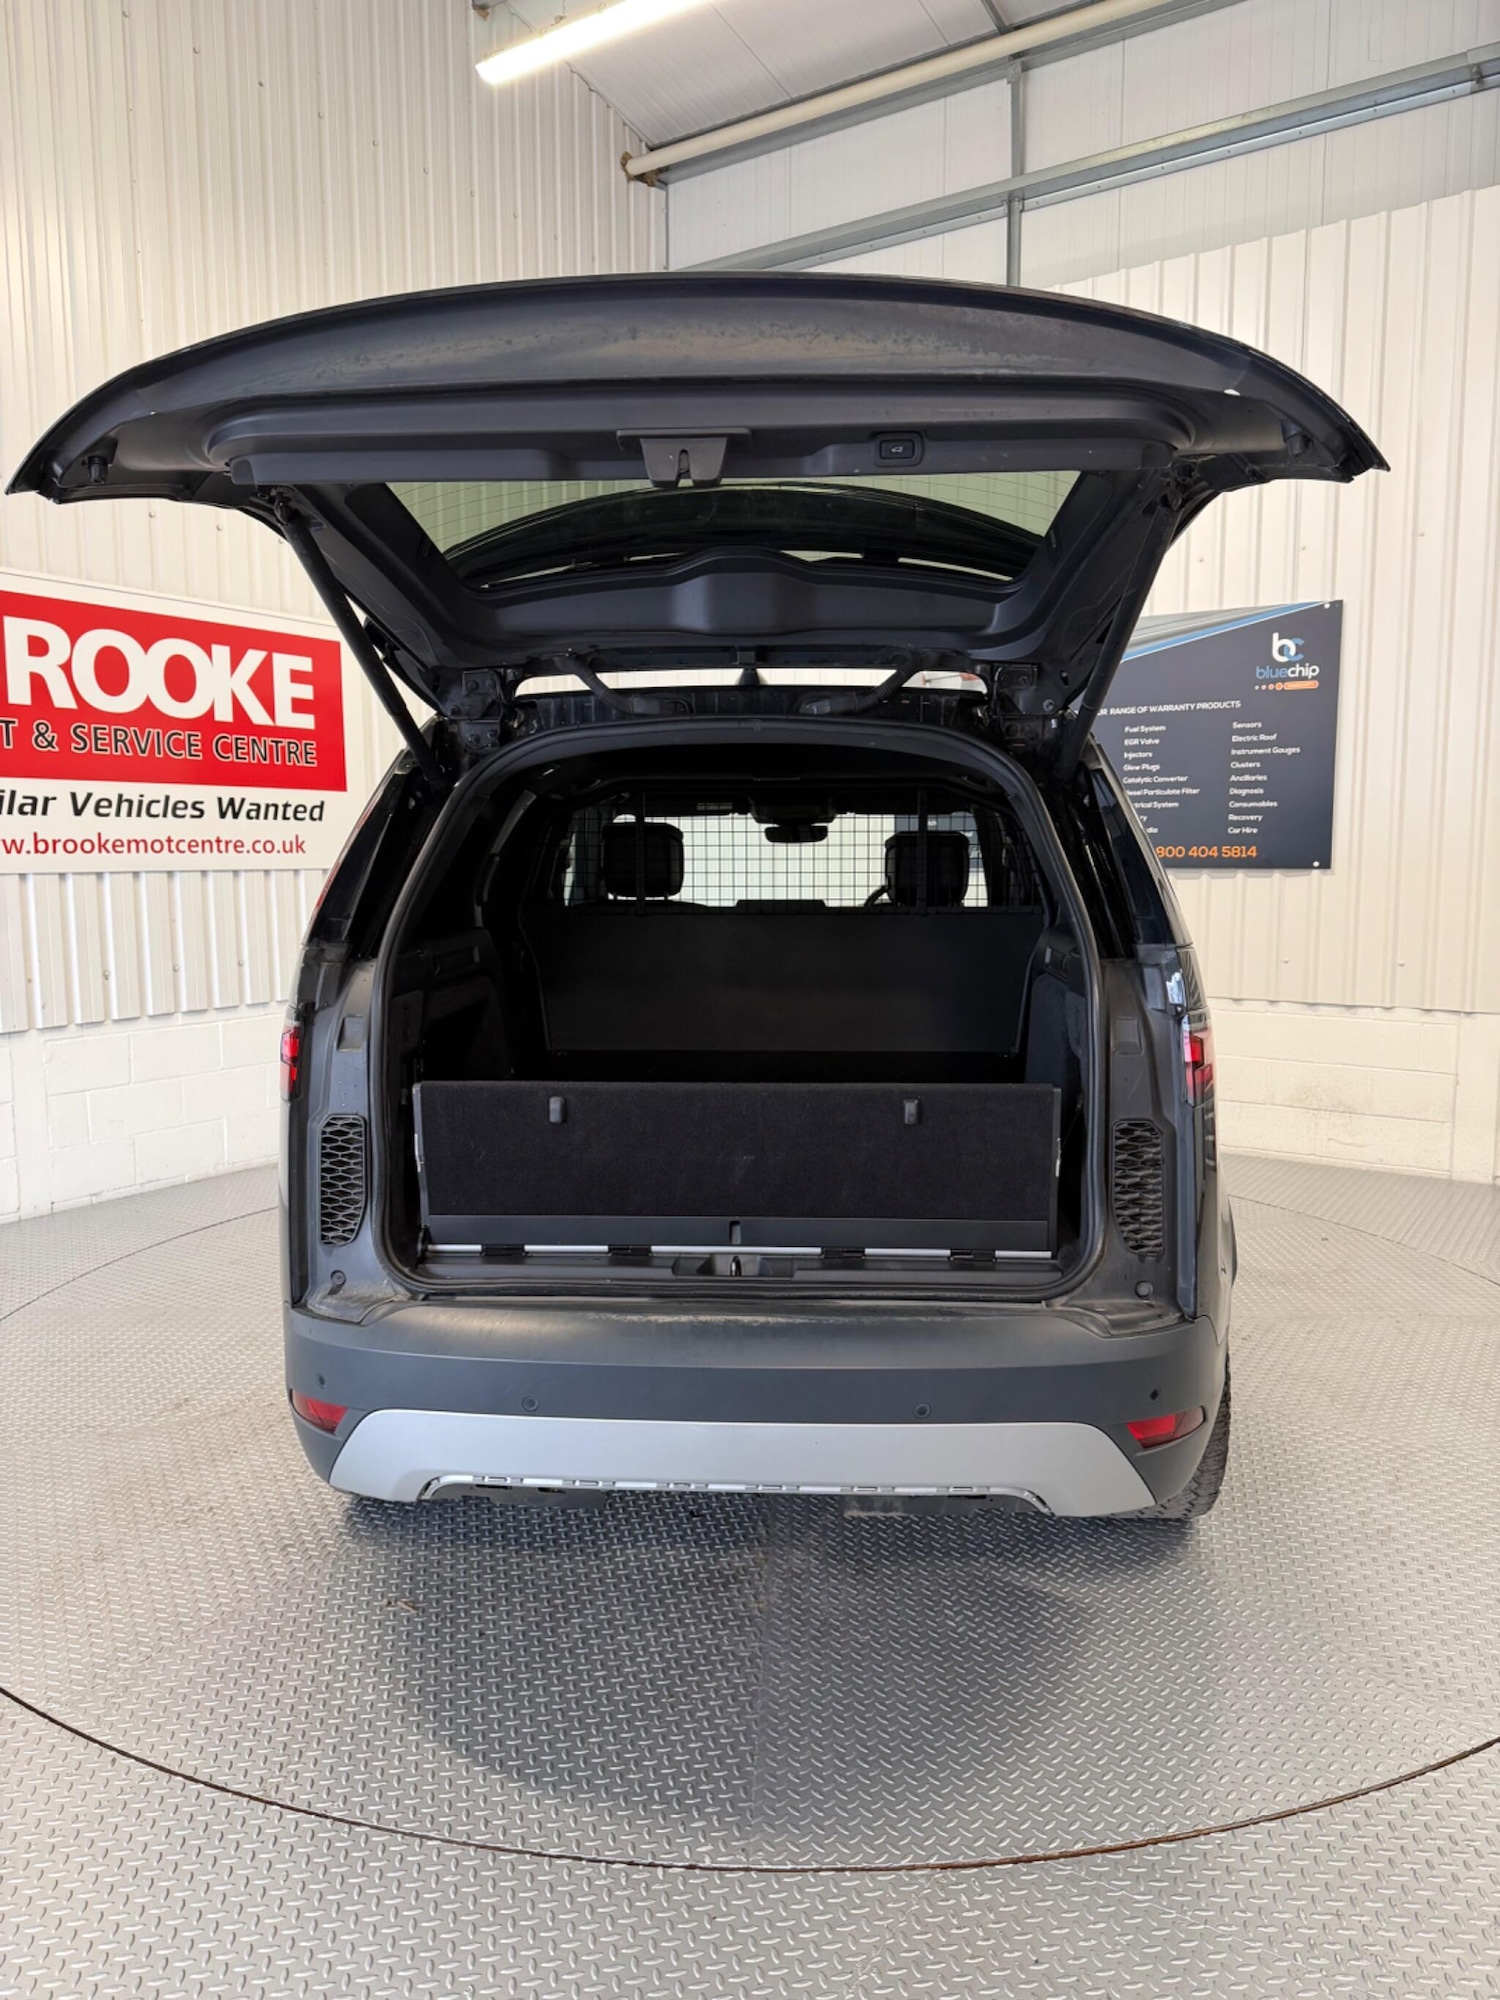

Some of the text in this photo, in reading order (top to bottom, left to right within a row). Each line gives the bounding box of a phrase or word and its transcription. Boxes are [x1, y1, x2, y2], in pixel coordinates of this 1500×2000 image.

[3, 615, 315, 730] ROOKE
[1256, 663, 1320, 679] bluechip
[1097, 700, 1241, 716] UR RANGE OF WARRANTY PRODUCTS
[1124, 724, 1166, 734] Fuel System
[1232, 721, 1262, 729] Sensors
[1140, 737, 1160, 745] Valve
[1231, 733, 1277, 742] Electric Roof
[32, 719, 59, 751] &
[70, 723, 202, 759] SERVICE
[213, 734, 317, 767] CENTRE
[1123, 751, 1153, 760] Injectors
[1231, 746, 1301, 756] Instrument Gauges
[1141, 763, 1160, 773] Plugs
[1230, 761, 1261, 769] Clusters
[1153, 775, 1189, 783] Converter
[1230, 774, 1268, 782] Ancillaries
[1181, 787, 1200, 795] Filter
[1229, 787, 1264, 797] Diagnosis
[69, 791, 205, 818] Vehicles
[216, 796, 325, 822] Wanted
[1153, 801, 1179, 810] System
[1228, 801, 1278, 809] Consumables
[1228, 814, 1263, 823] Recovery
[2, 831, 306, 855] w.brookemotcentre.co.uk
[1155, 845, 1257, 858] 800 404 5814
